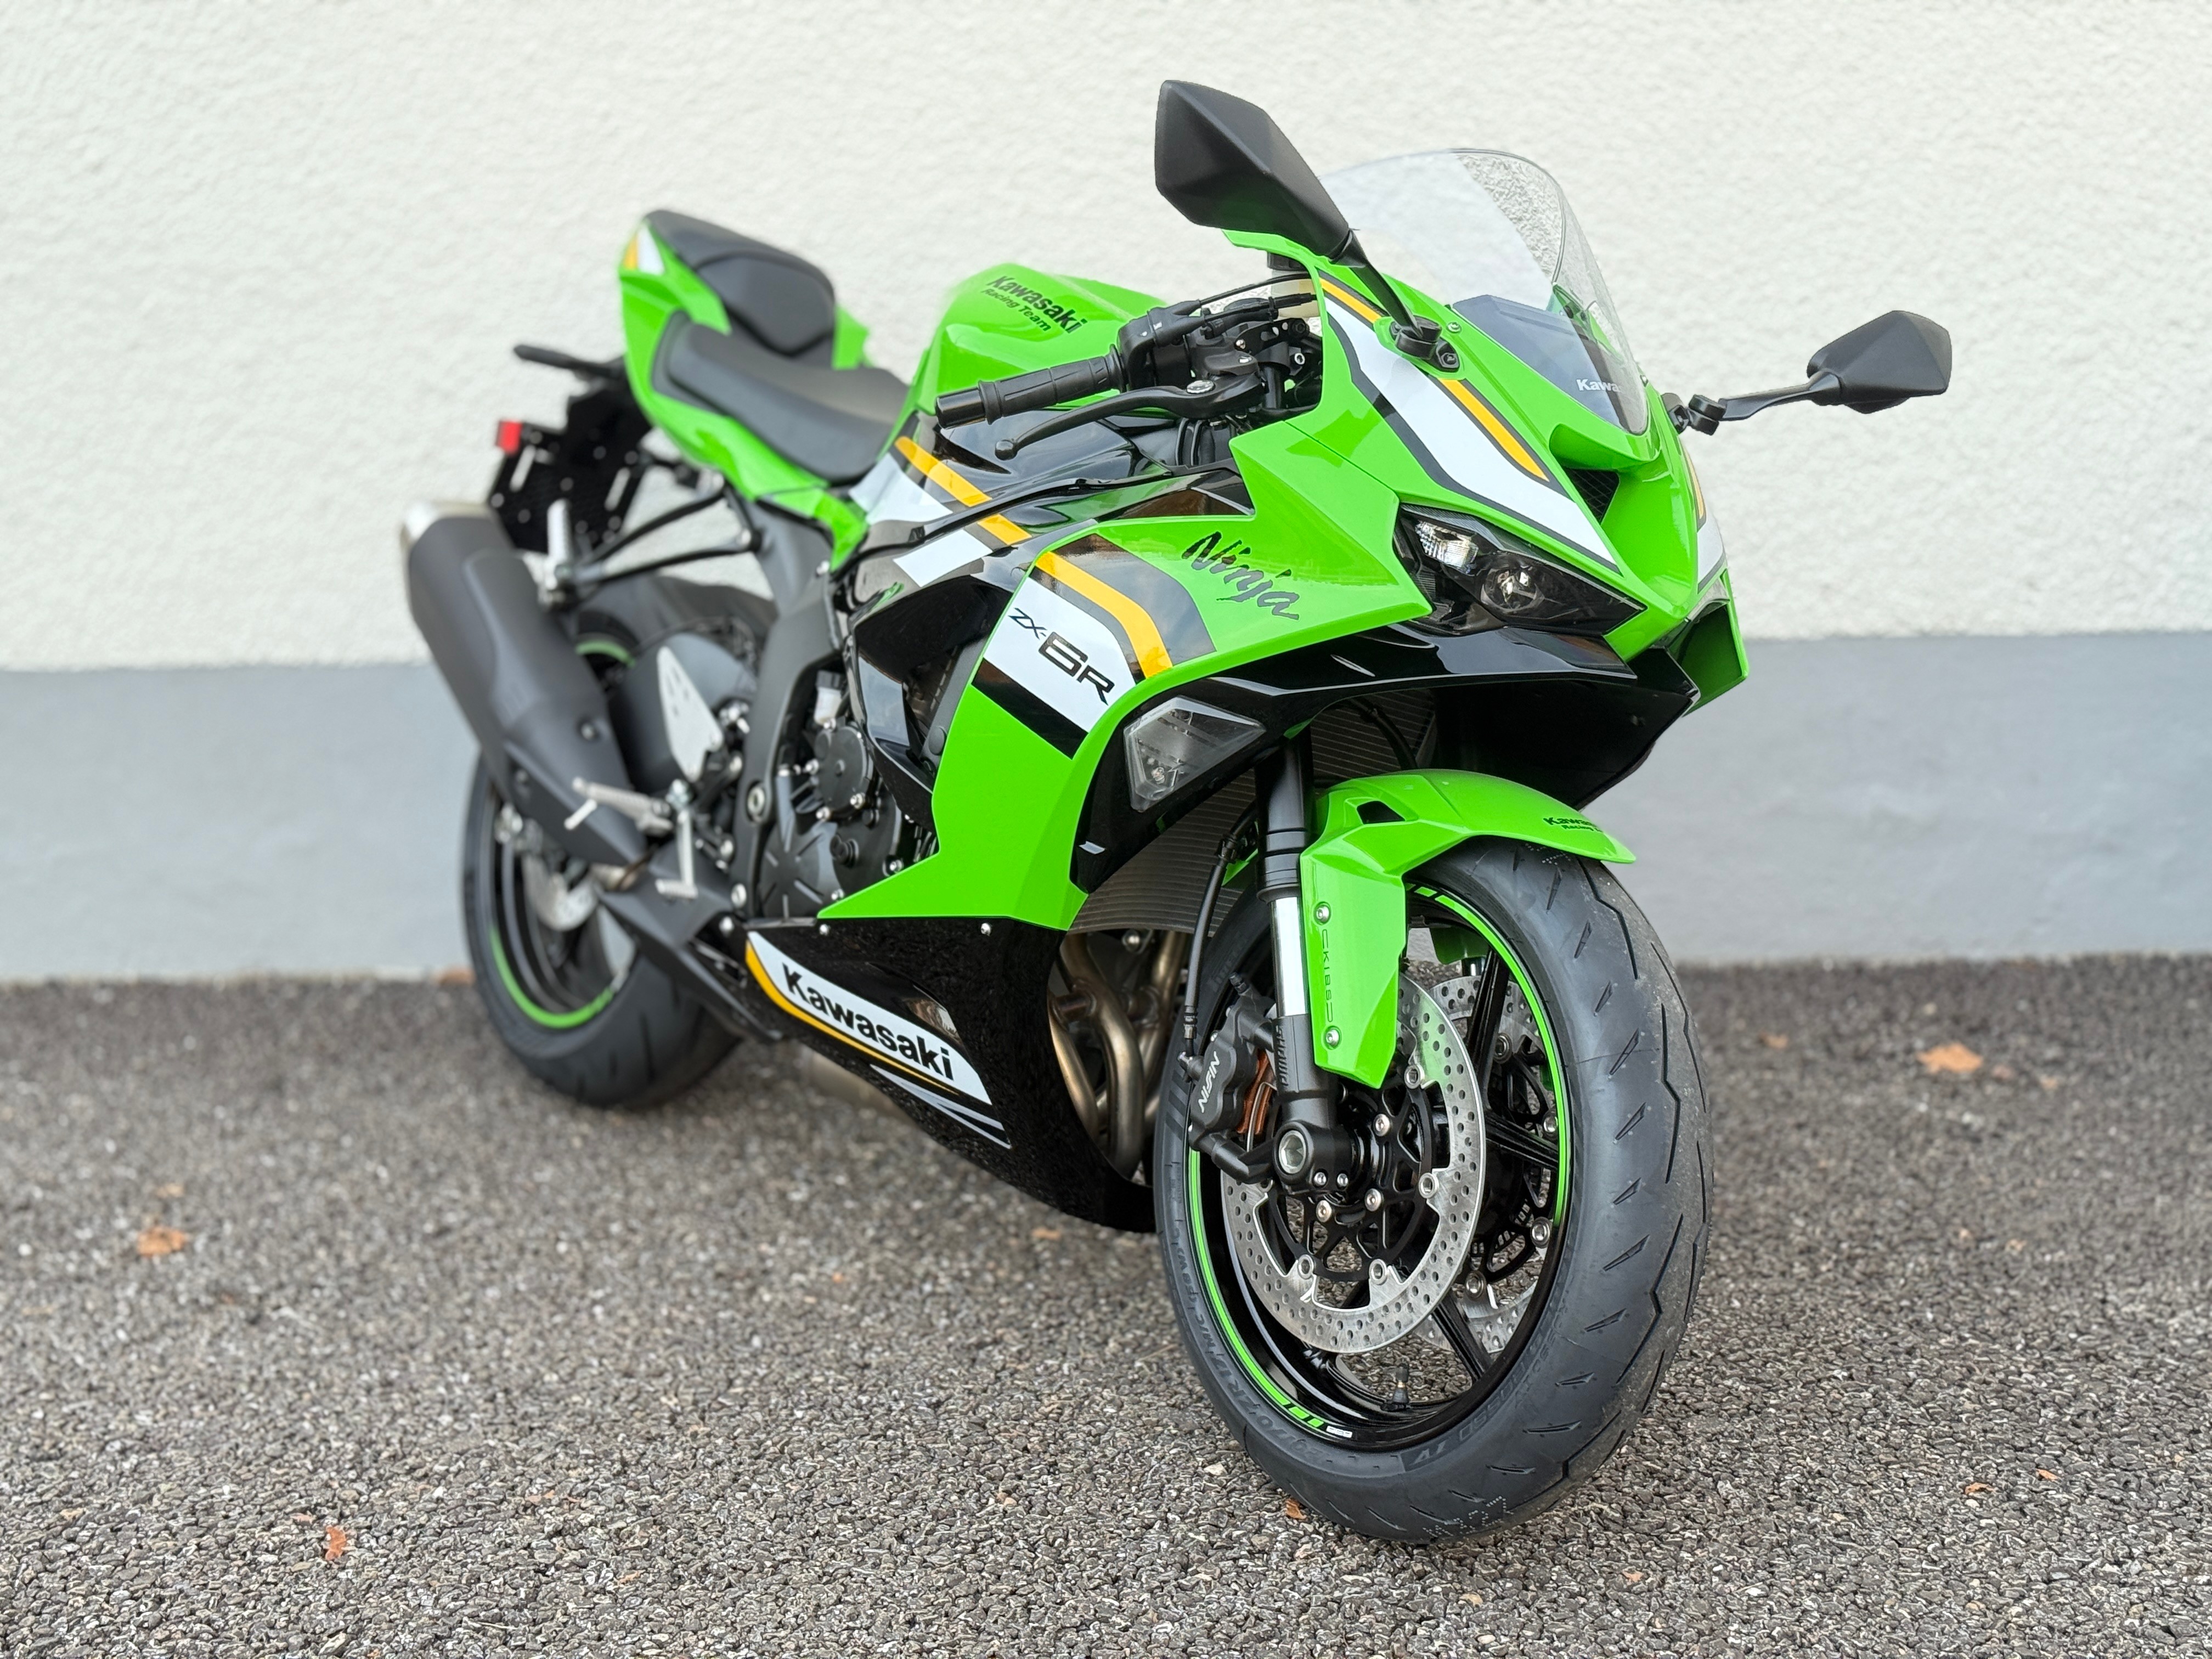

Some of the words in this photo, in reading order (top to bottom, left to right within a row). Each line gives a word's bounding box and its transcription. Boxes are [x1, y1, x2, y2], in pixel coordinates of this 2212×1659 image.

[981, 289, 1020, 309] Racing
[1018, 305, 1052, 331] Team
[986, 275, 1088, 334] Kawasaki
[1576, 379, 1622, 392] Kawa
[1181, 531, 1301, 620] Ninja
[1008, 607, 1115, 706] ZX-6R
[782, 963, 954, 1081] Kawasaki
[1198, 1051, 1221, 1114] NISSIN
